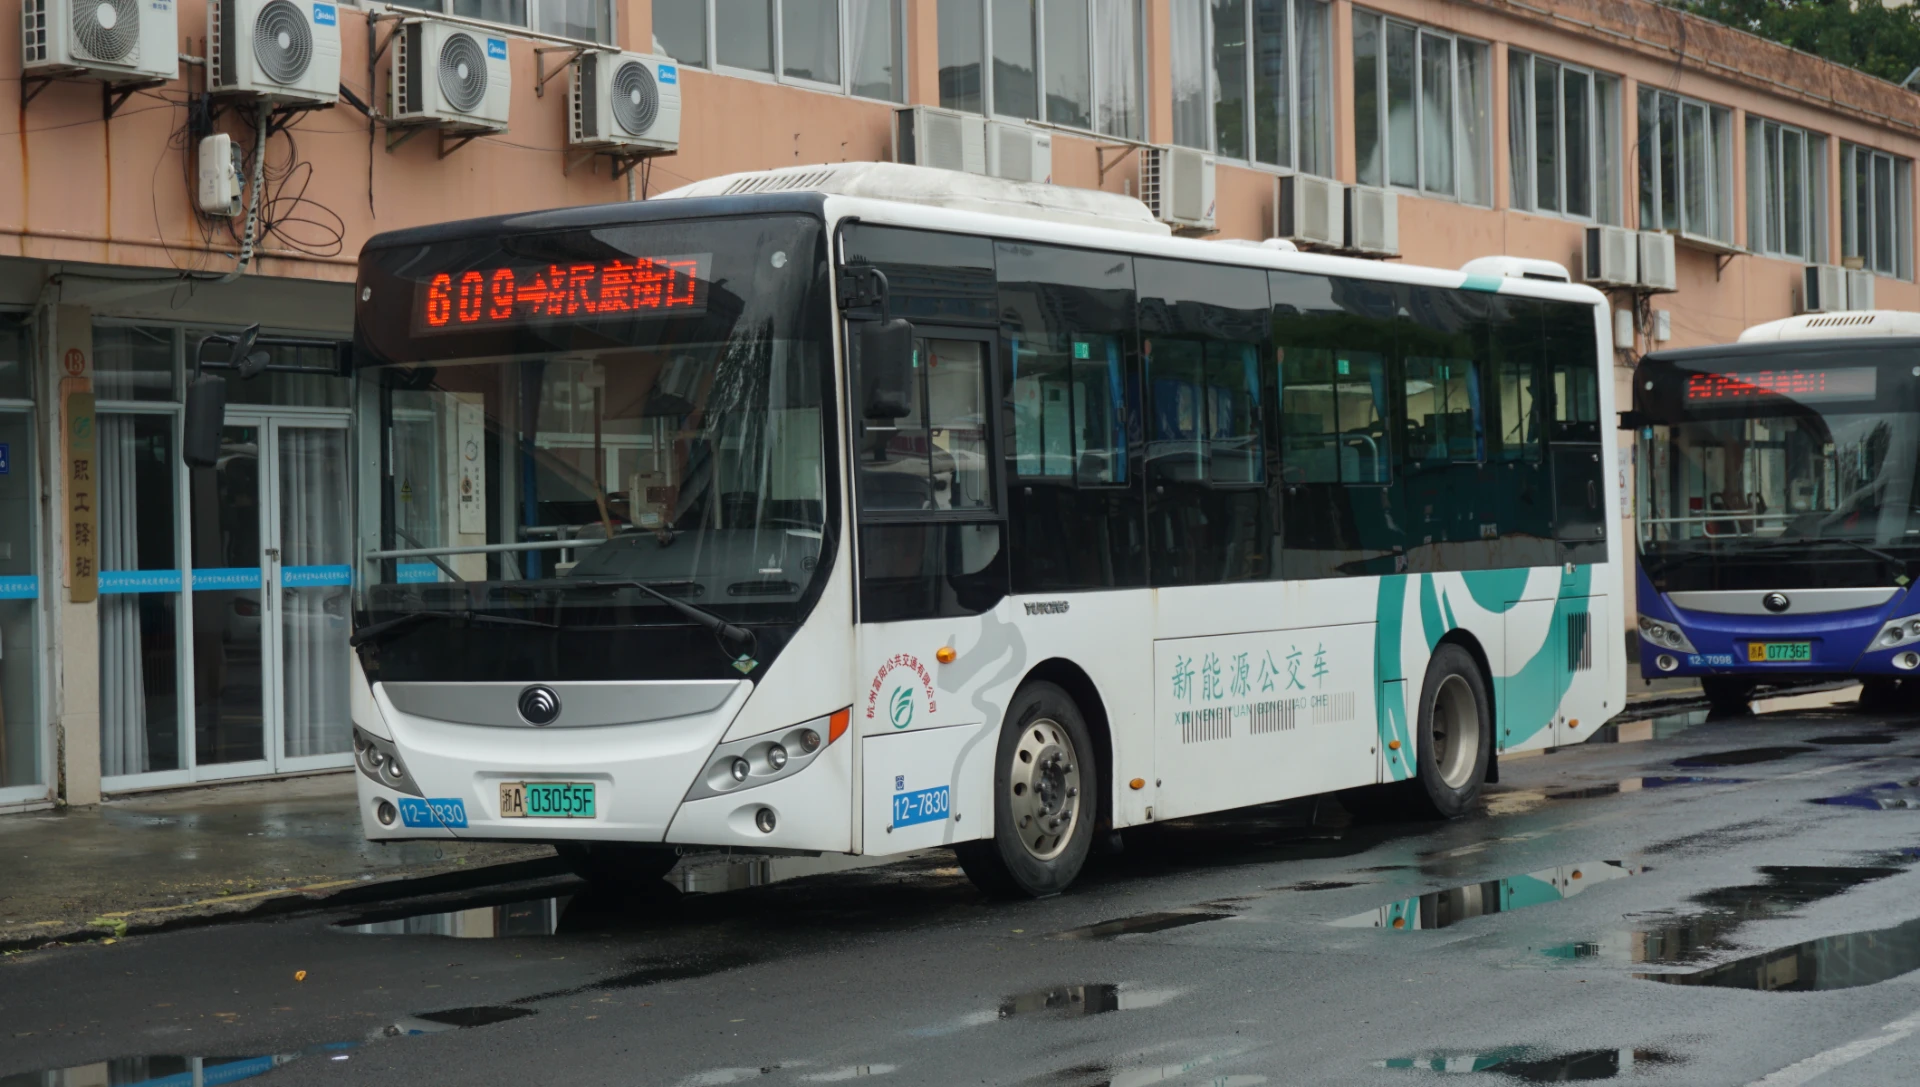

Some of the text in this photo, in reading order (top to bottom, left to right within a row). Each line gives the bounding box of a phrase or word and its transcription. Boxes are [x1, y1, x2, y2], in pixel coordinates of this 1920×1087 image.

[428, 268, 515, 326] 609
[67, 352, 83, 373] 13
[1023, 600, 1070, 616] YUTONG
[866, 653, 937, 720] 杭州富阳公共交通有限公司
[1171, 642, 1330, 705] 新能源公交车
[1228, 703, 1252, 719] YUAN
[1310, 694, 1328, 708] CHE
[402, 803, 465, 824] 12-7830
[531, 788, 593, 814] 03055F
[894, 789, 949, 821] 12-7830
